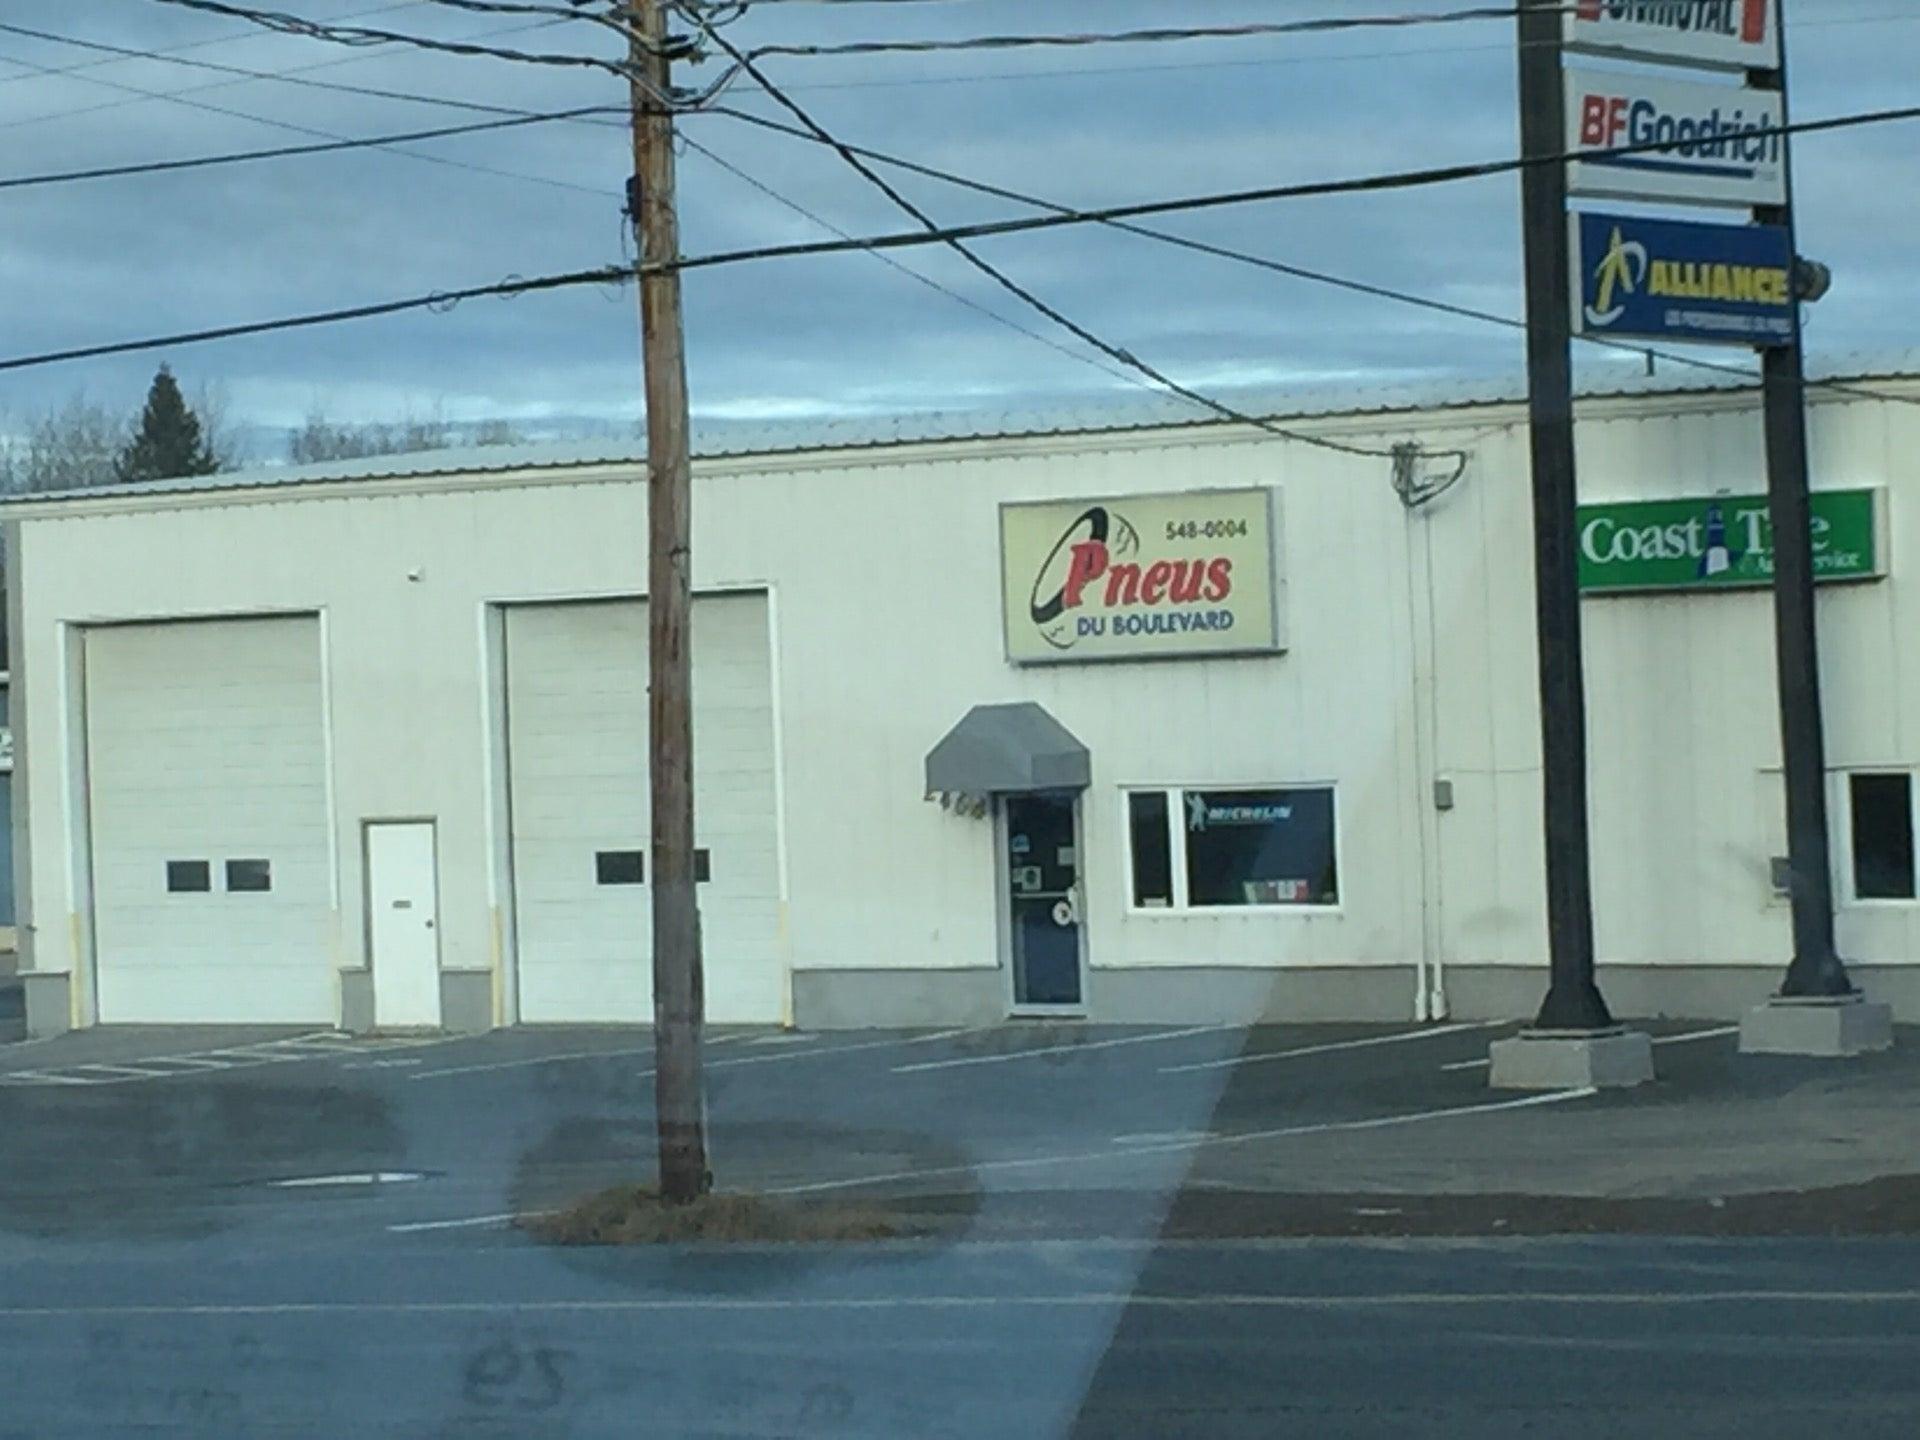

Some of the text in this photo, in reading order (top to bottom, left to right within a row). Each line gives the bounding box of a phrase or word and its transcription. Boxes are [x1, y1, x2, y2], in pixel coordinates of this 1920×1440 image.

[1580, 94, 1778, 163] BFGoodrich
[1648, 260, 1789, 305] ALLIANCE
[1166, 519, 1247, 539] 548-0004
[1580, 506, 1831, 564] Coast Te
[1063, 539, 1233, 609] Pneus
[1076, 609, 1234, 637] DU BOULEVARD
[1208, 806, 1292, 820] MICHELIN
